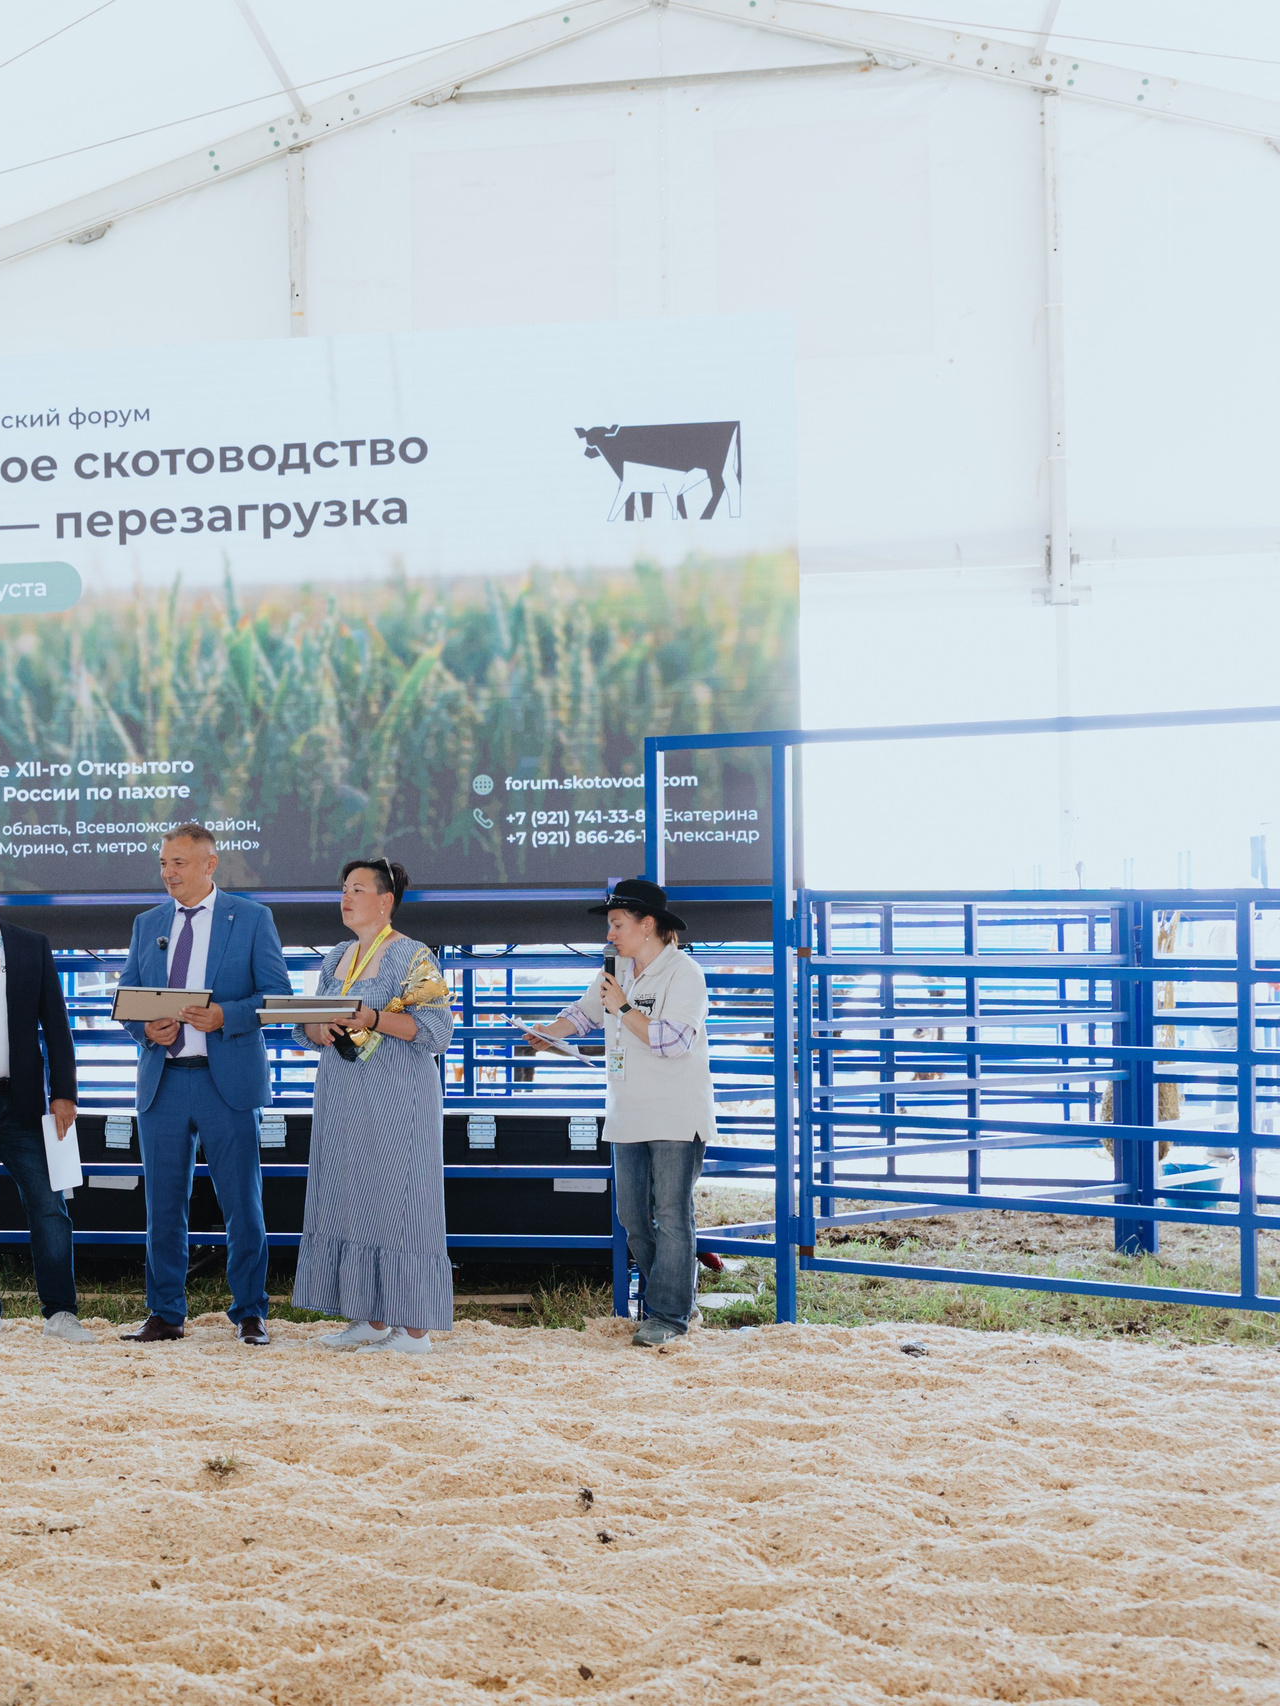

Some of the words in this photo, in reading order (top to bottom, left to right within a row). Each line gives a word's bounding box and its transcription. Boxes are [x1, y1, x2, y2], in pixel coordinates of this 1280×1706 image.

[68, 407, 151, 430] форум
[73, 436, 429, 480] скотоводство
[55, 496, 409, 545] перезагрузка
[15, 761, 72, 777] XII-го
[77, 760, 194, 778] Открытого
[3, 787, 80, 802] России
[86, 787, 112, 801] по
[118, 785, 191, 801] пахоте
[2, 821, 72, 836] область,
[75, 818, 198, 833] Всеволожск
[204, 817, 261, 833] район,
[506, 811, 526, 825] +7
[531, 810, 570, 828] (921)
[574, 809, 646, 825] 741-33-8
[663, 808, 759, 825] Екатерина
[506, 831, 526, 845] +7
[531, 830, 570, 848] (921)
[575, 829, 647, 845] 866-26-1
[662, 828, 760, 845] Александр
[0, 841, 69, 858] Мурино,
[72, 842, 93, 855] ст.
[97, 842, 147, 855] метро
